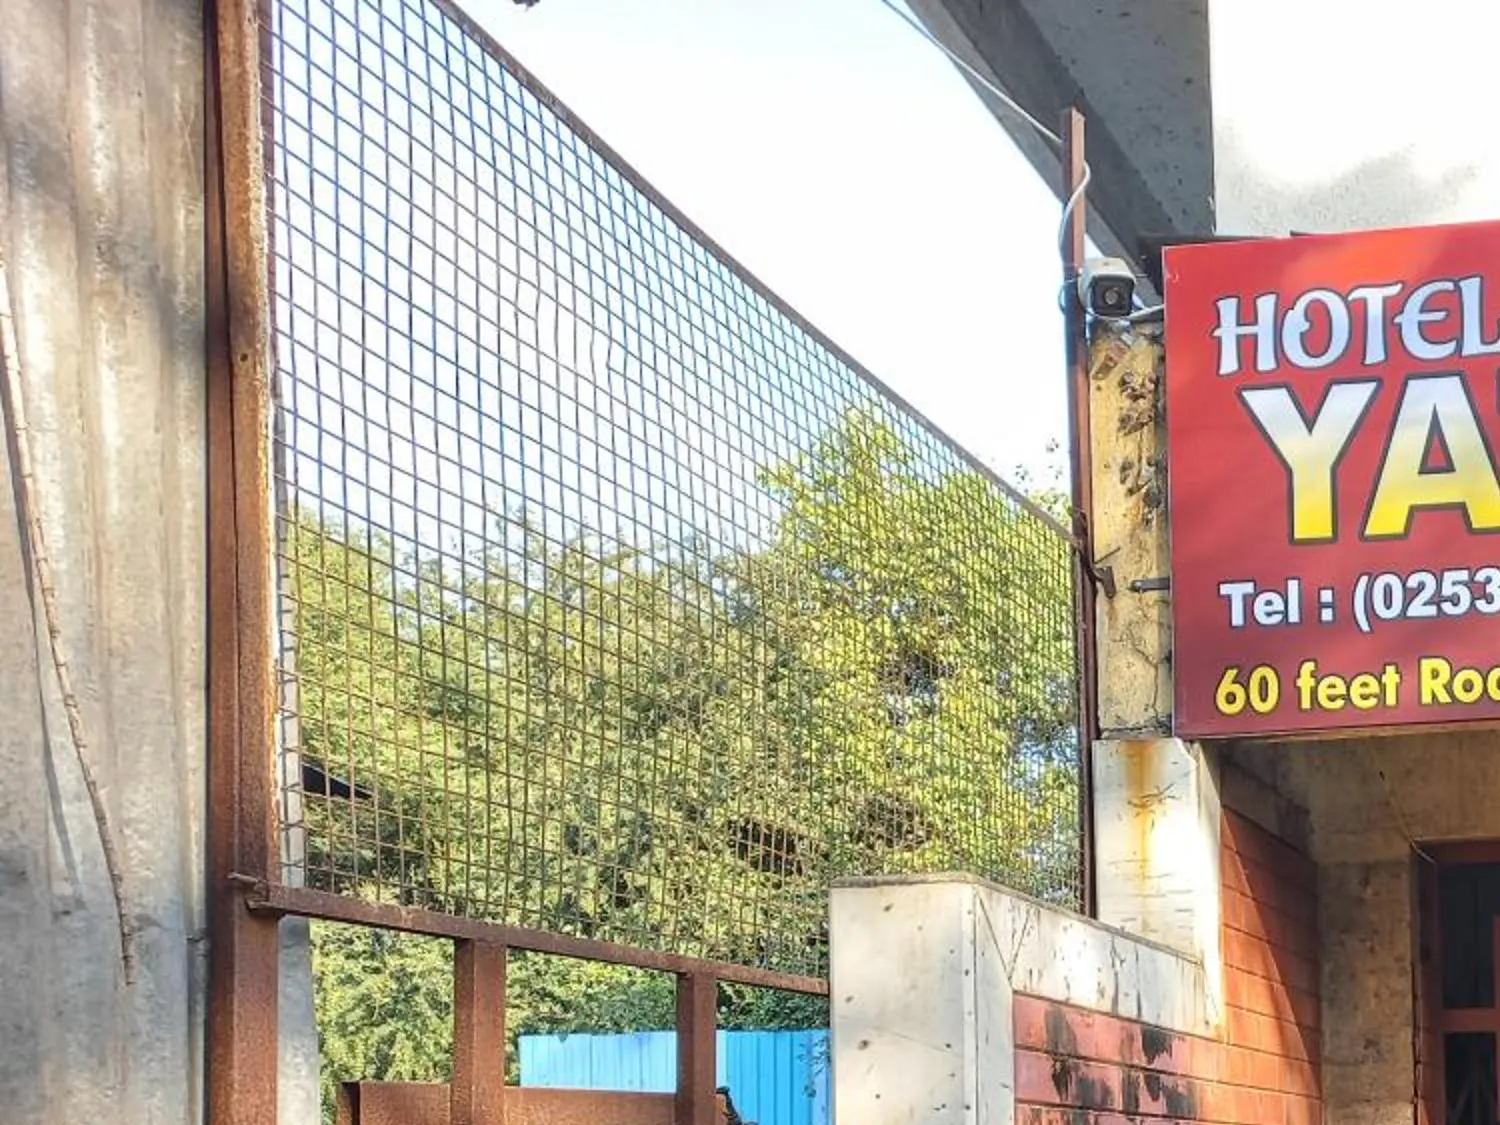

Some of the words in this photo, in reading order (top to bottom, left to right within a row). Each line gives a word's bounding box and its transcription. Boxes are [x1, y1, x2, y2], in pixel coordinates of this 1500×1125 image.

[1219, 580, 1302, 628] Tel
[1318, 587, 1335, 623] :
[1214, 665, 1281, 717] 60
[1296, 660, 1400, 712] feet
